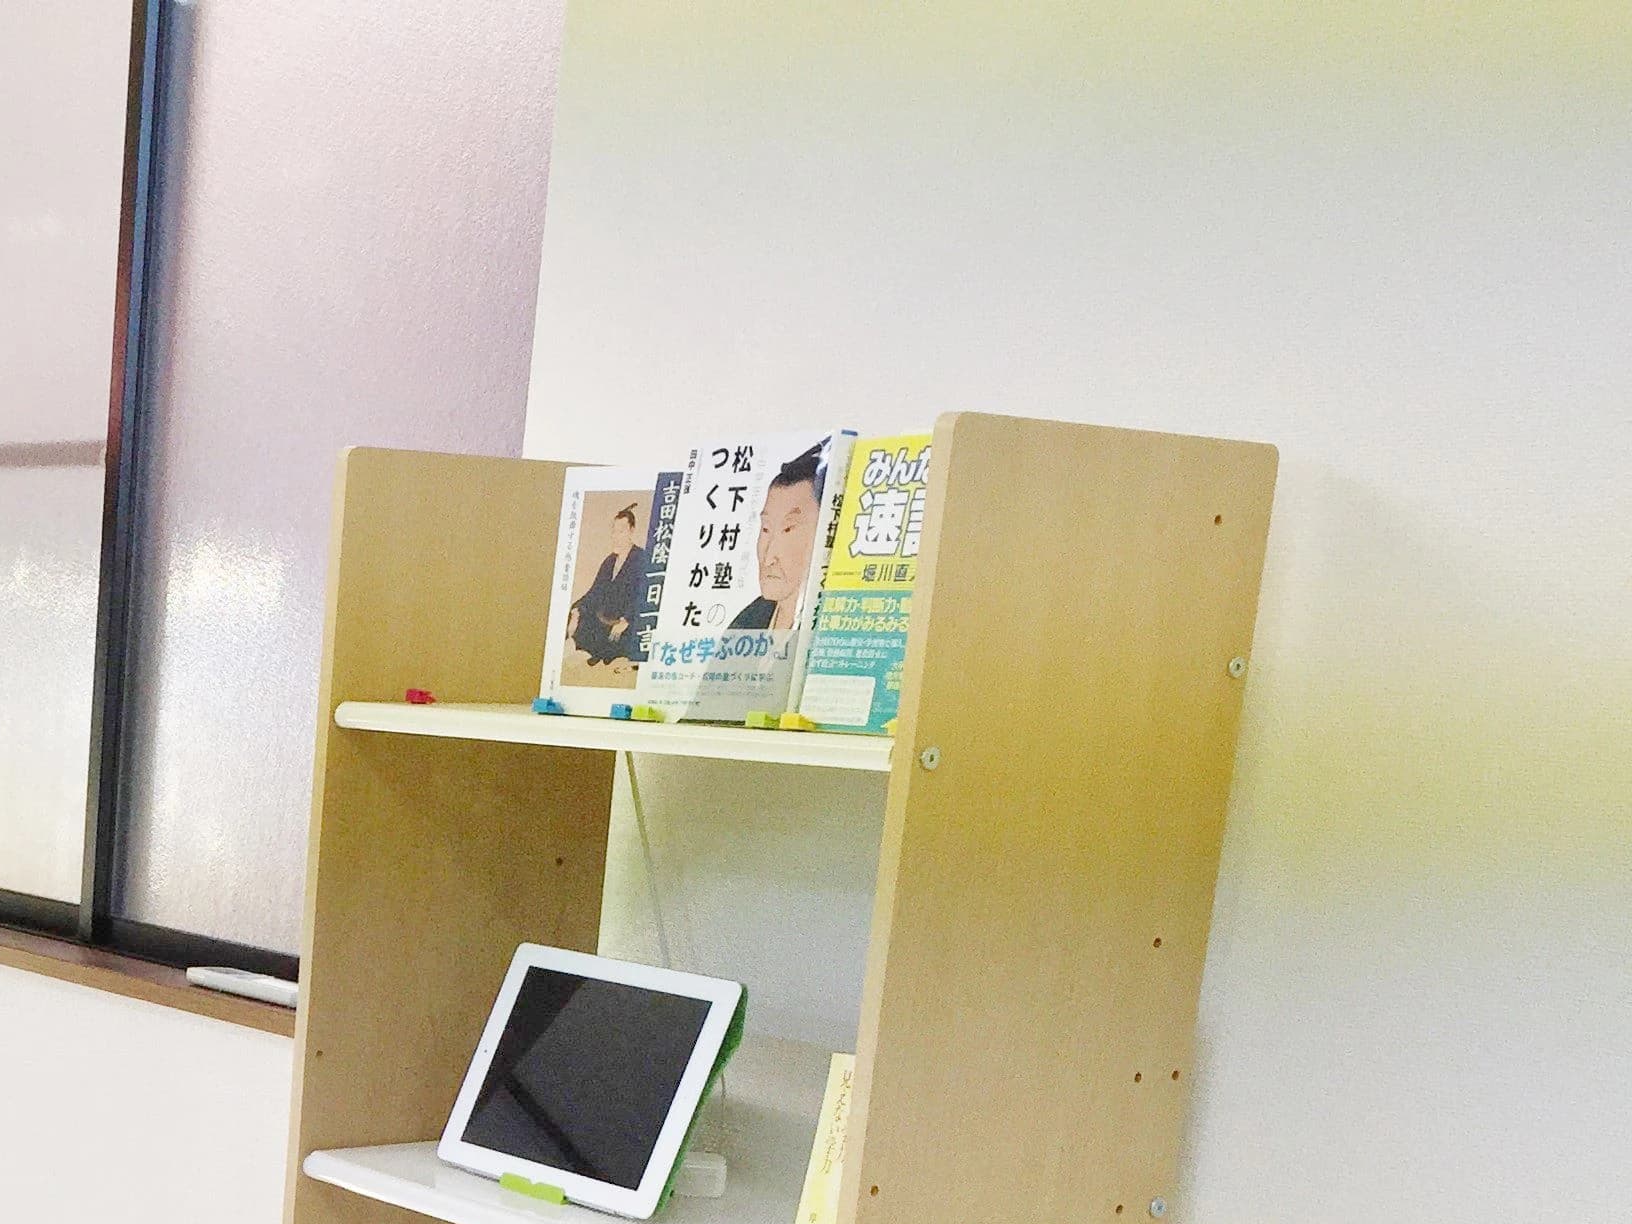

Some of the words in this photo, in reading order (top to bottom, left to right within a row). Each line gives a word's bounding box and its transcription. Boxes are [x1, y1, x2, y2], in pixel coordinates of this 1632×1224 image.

[682, 447, 729, 627] つくりかた
[707, 445, 754, 627] 松下村塾の
[862, 563, 915, 582] 堀川直
